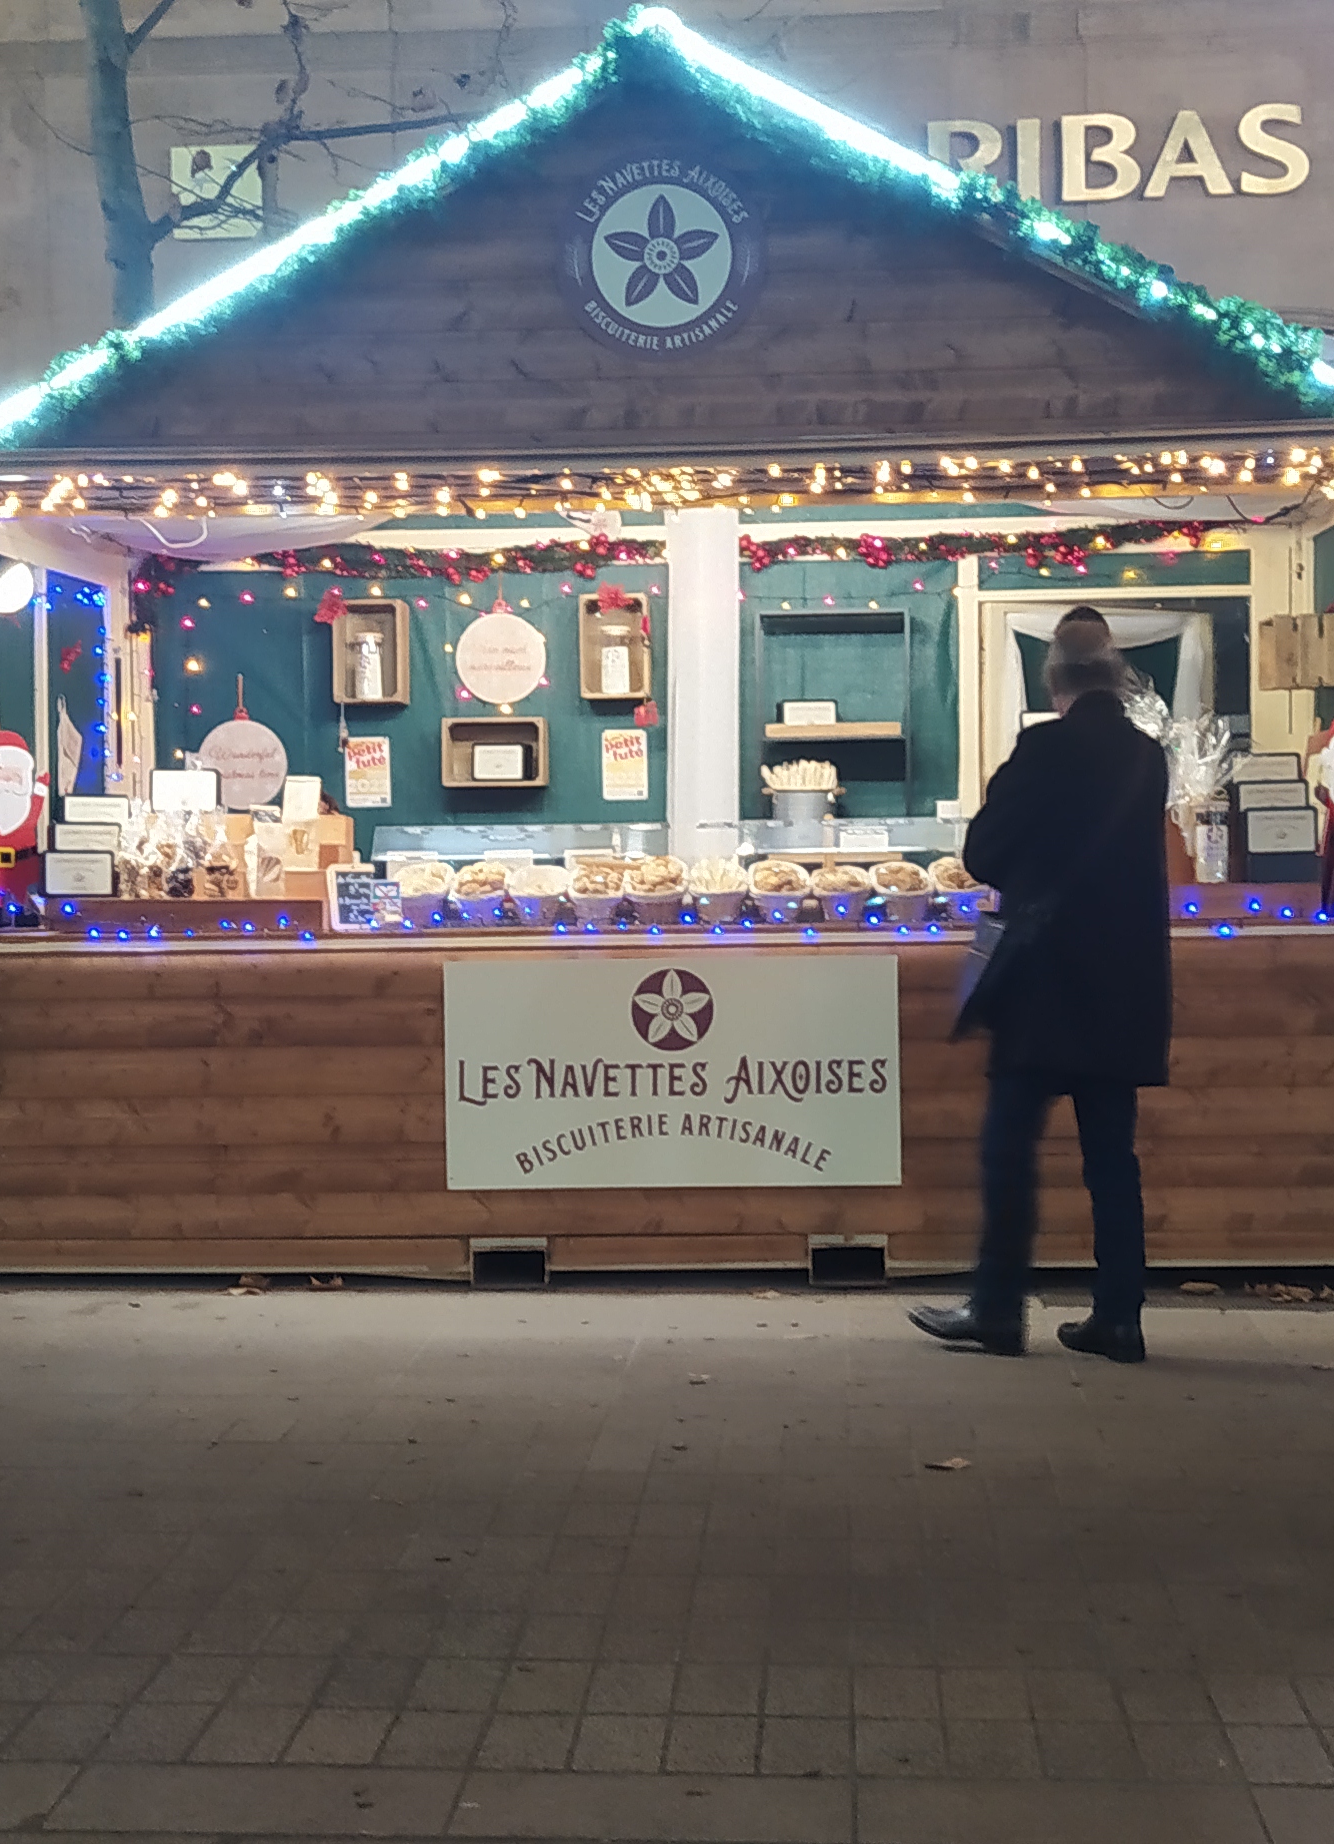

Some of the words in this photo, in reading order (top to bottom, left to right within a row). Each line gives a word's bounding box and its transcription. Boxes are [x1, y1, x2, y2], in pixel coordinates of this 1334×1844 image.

[927, 103, 1310, 201] RIBAS
[597, 159, 681, 196] NAVETTES
[683, 165, 749, 224] AIXOISES
[584, 300, 660, 350] BISCUITERIE
[665, 300, 739, 350] ARTISANALE
[458, 1059, 522, 1106] LES
[526, 1057, 709, 1100] NAVETTES
[723, 1055, 888, 1105] AIXOISES
[515, 1113, 669, 1175] BISCUITERIE
[680, 1113, 832, 1172] ARTISANALE
